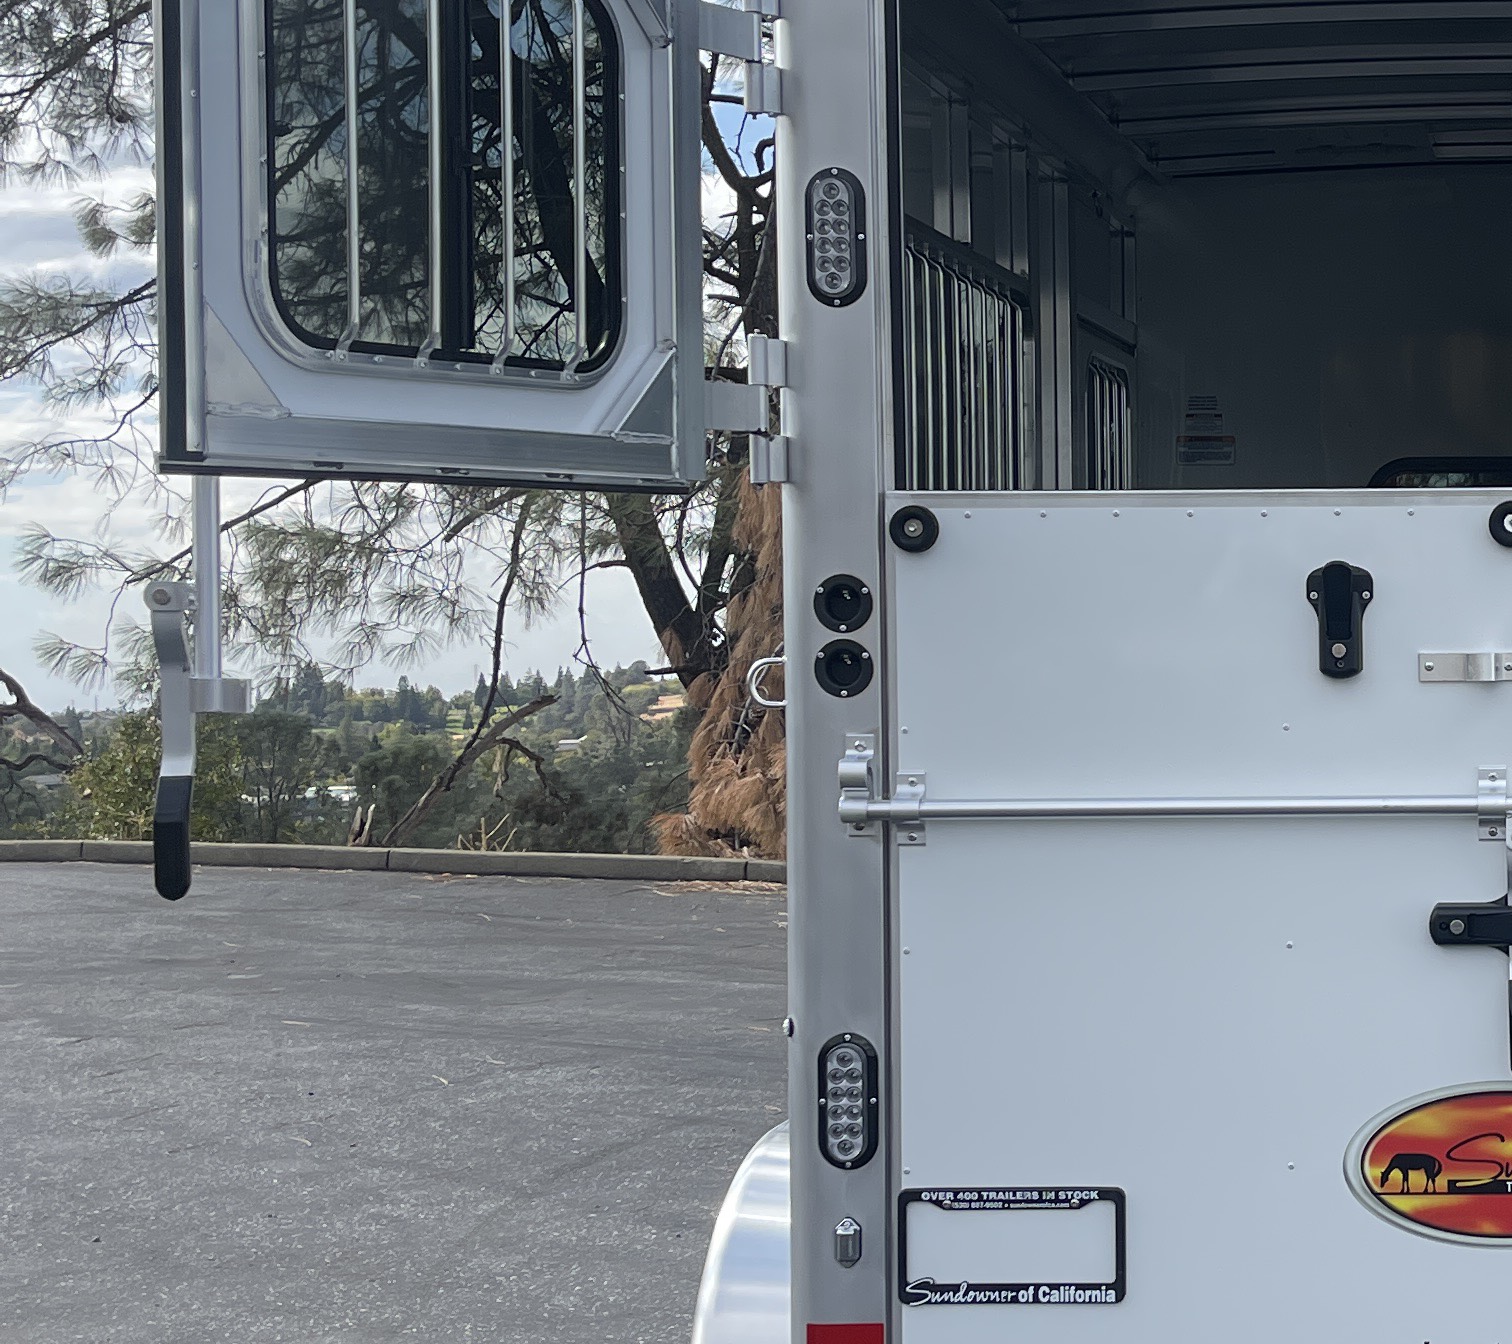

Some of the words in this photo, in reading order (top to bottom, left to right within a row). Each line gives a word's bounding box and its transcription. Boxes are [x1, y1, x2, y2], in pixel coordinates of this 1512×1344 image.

[921, 1191, 955, 1201] OVER
[956, 1191, 979, 1201] 400
[980, 1190, 1040, 1201] TRAILERS
[1042, 1190, 1056, 1200] IN
[1058, 1190, 1100, 1200] STOCK
[905, 1277, 1017, 1307] Sundowner
[1017, 1286, 1034, 1303] of
[1038, 1285, 1116, 1303] California
